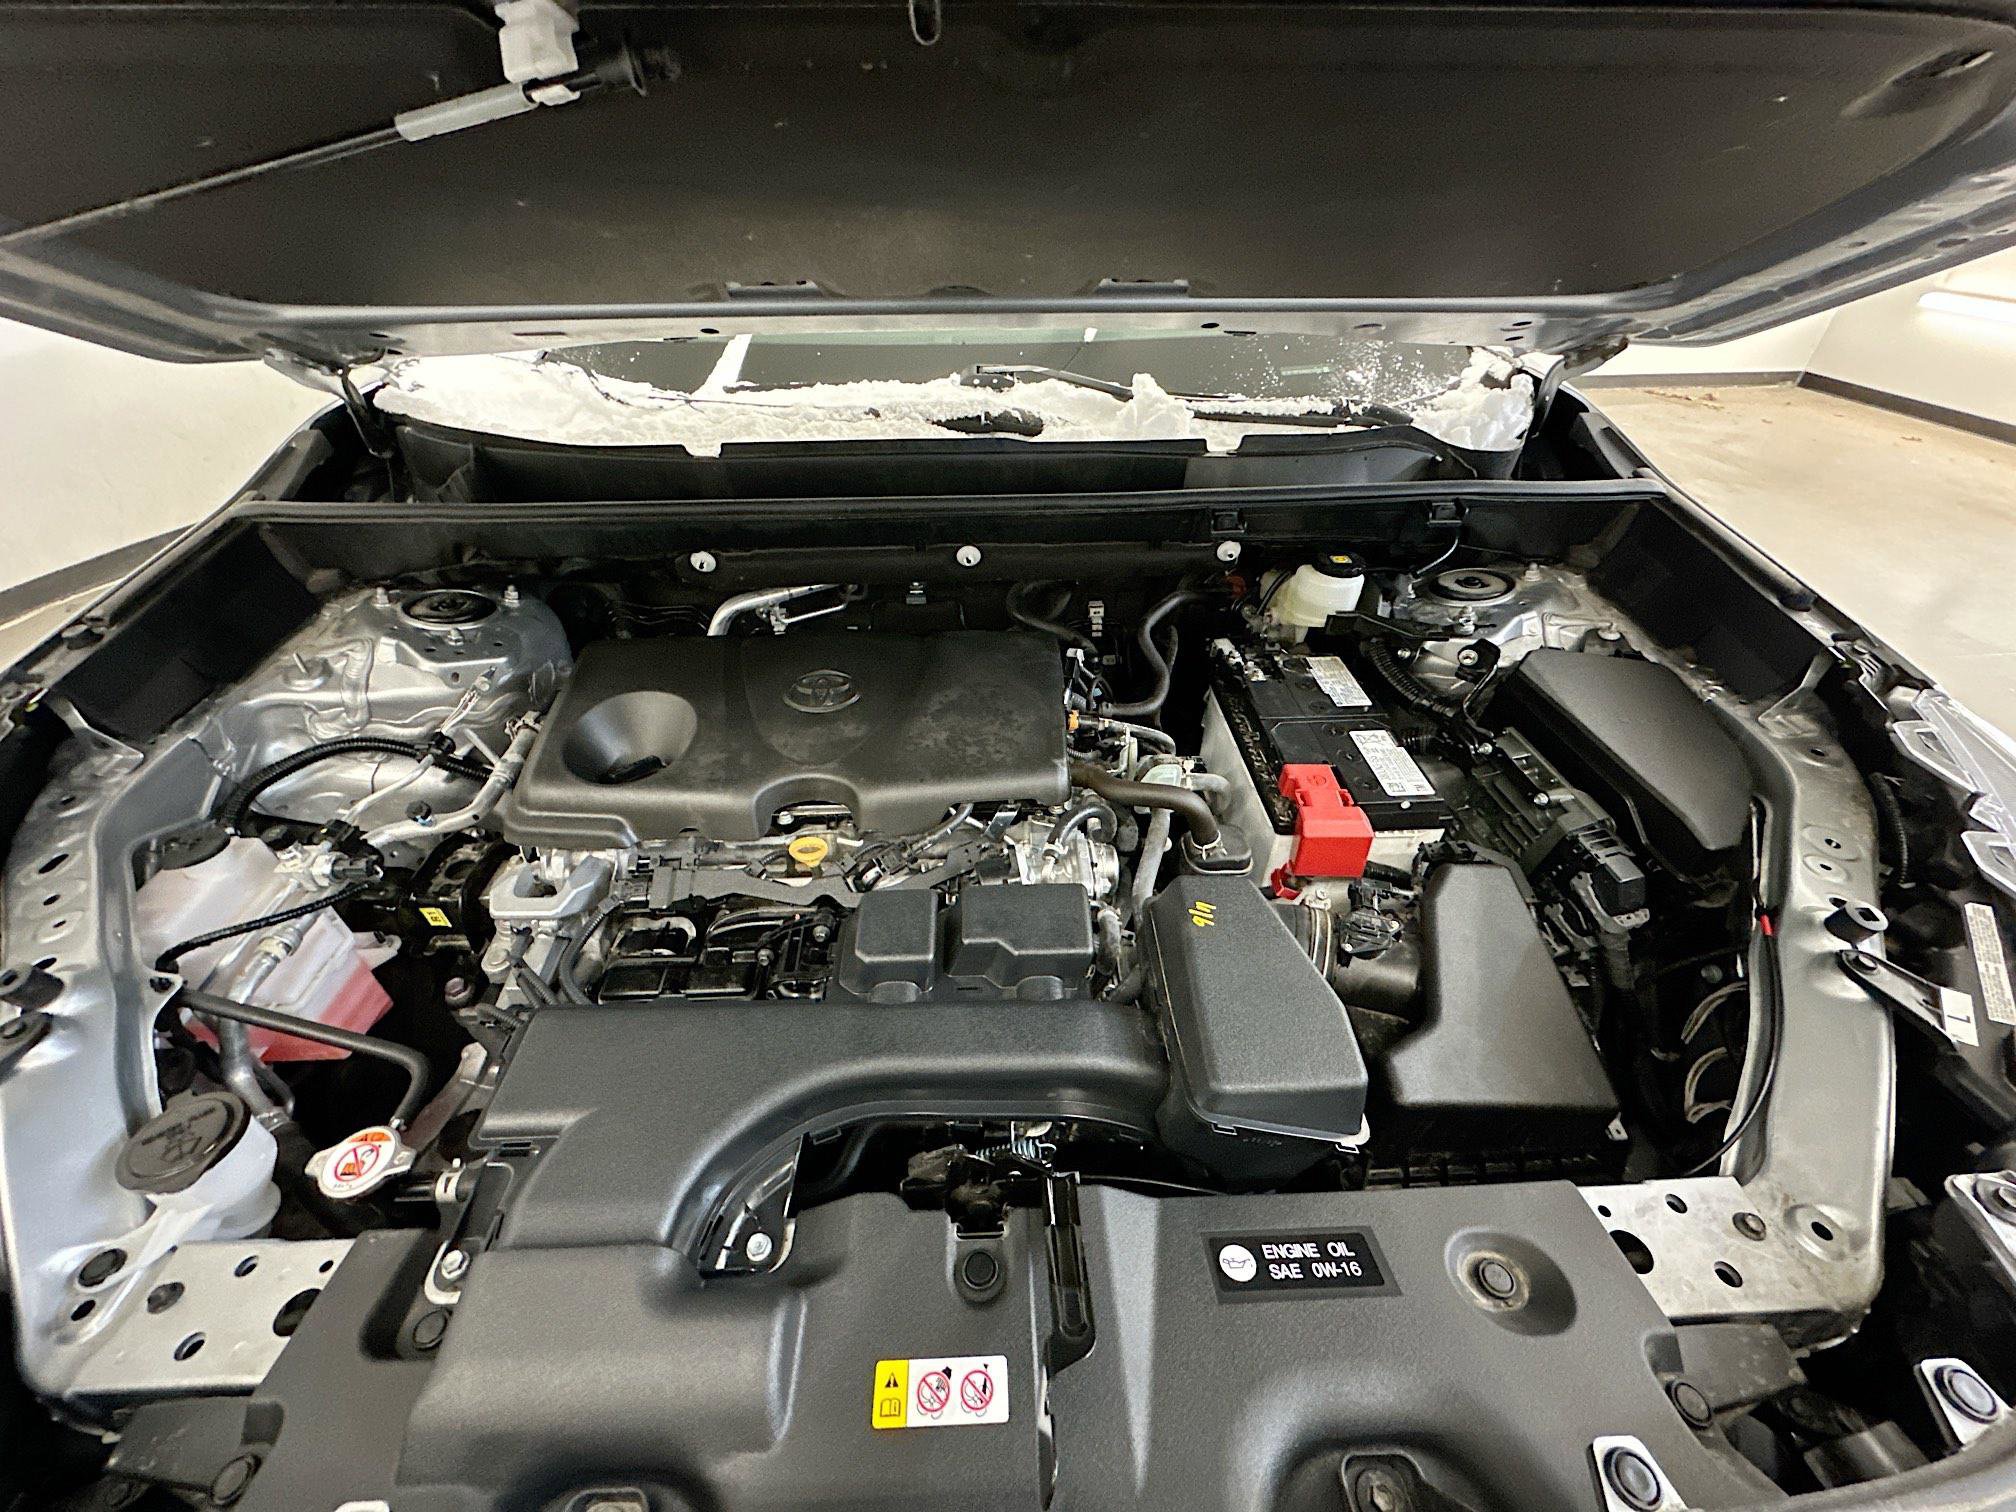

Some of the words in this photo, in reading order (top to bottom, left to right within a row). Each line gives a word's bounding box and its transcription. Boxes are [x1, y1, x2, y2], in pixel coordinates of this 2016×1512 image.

[1261, 1243, 1321, 1260] ENGINE
[1327, 1241, 1356, 1258] OIL
[1268, 1263, 1304, 1280] SAE
[1311, 1261, 1363, 1278] 0W-16
